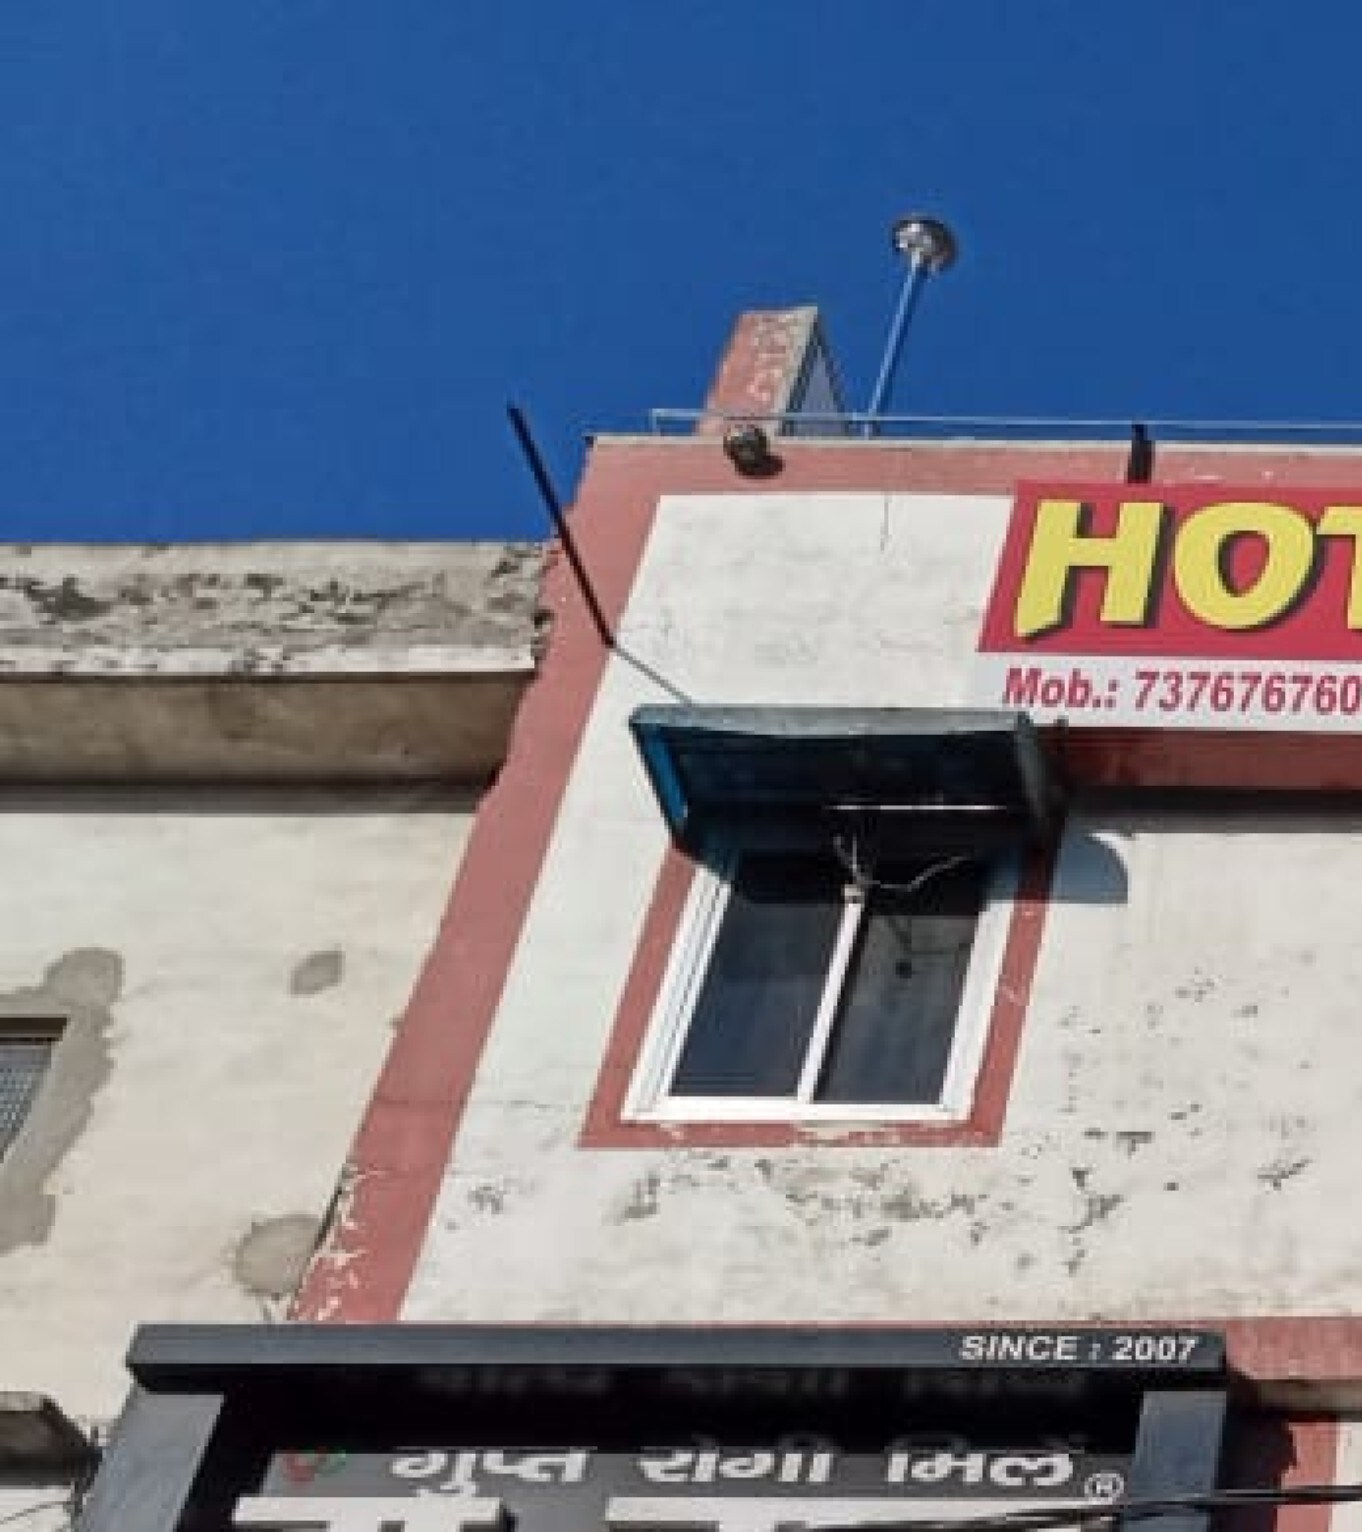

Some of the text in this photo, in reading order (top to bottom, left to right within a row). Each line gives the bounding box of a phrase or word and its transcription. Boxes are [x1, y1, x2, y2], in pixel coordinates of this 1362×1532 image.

[1003, 667, 1118, 709] Mob.:
[960, 1335, 1080, 1361] SINCE
[1111, 1335, 1200, 1361] 2007
